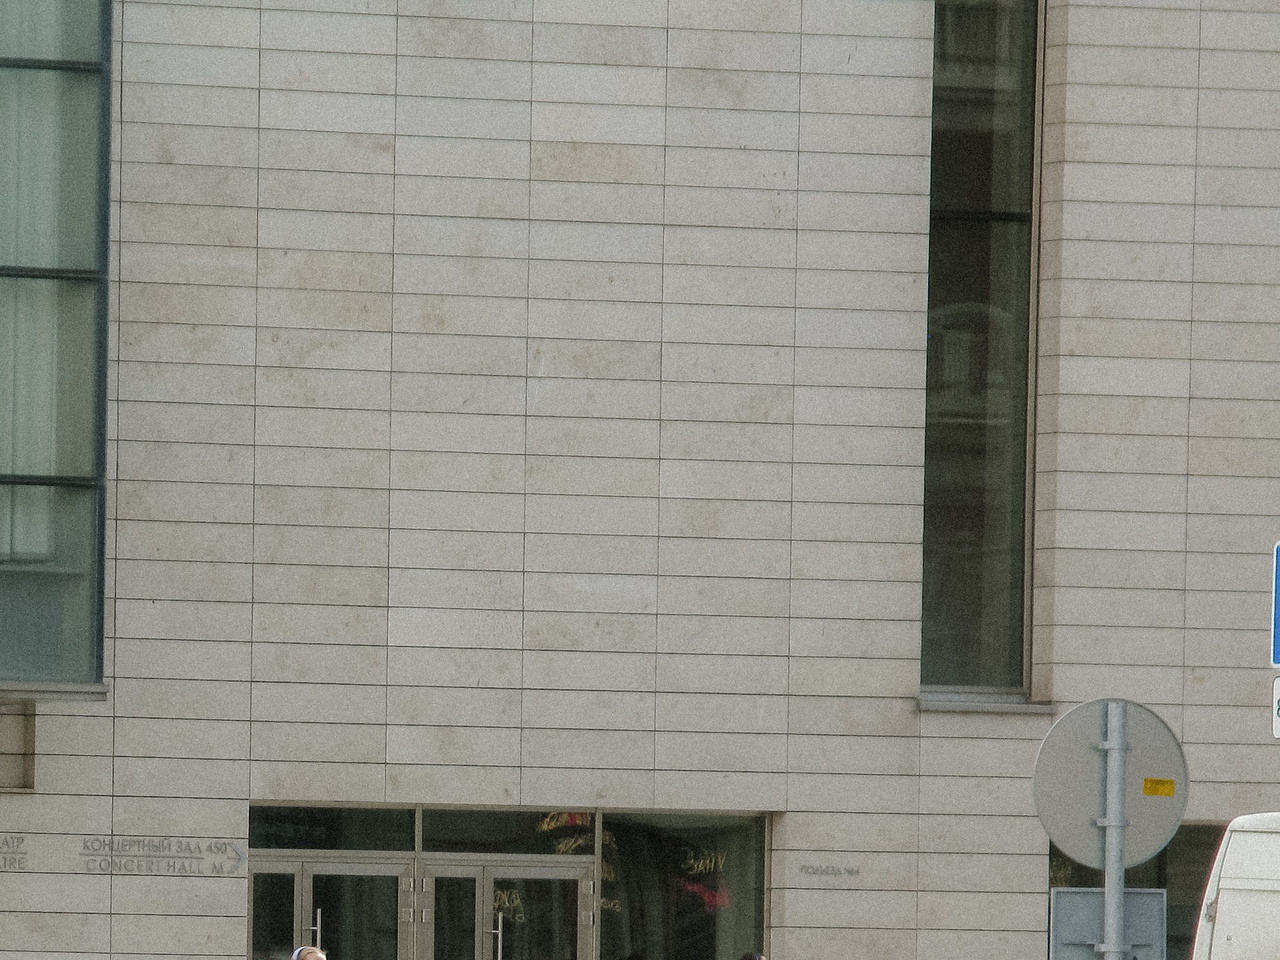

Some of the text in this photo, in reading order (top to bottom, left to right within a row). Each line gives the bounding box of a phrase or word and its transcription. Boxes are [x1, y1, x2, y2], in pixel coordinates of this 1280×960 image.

[82, 837, 172, 854] КОНЦЕРТНЫЙ
[175, 841, 202, 854] ЗАЛ
[85, 858, 161, 873] CONCERT
[166, 860, 204, 874] HALL
